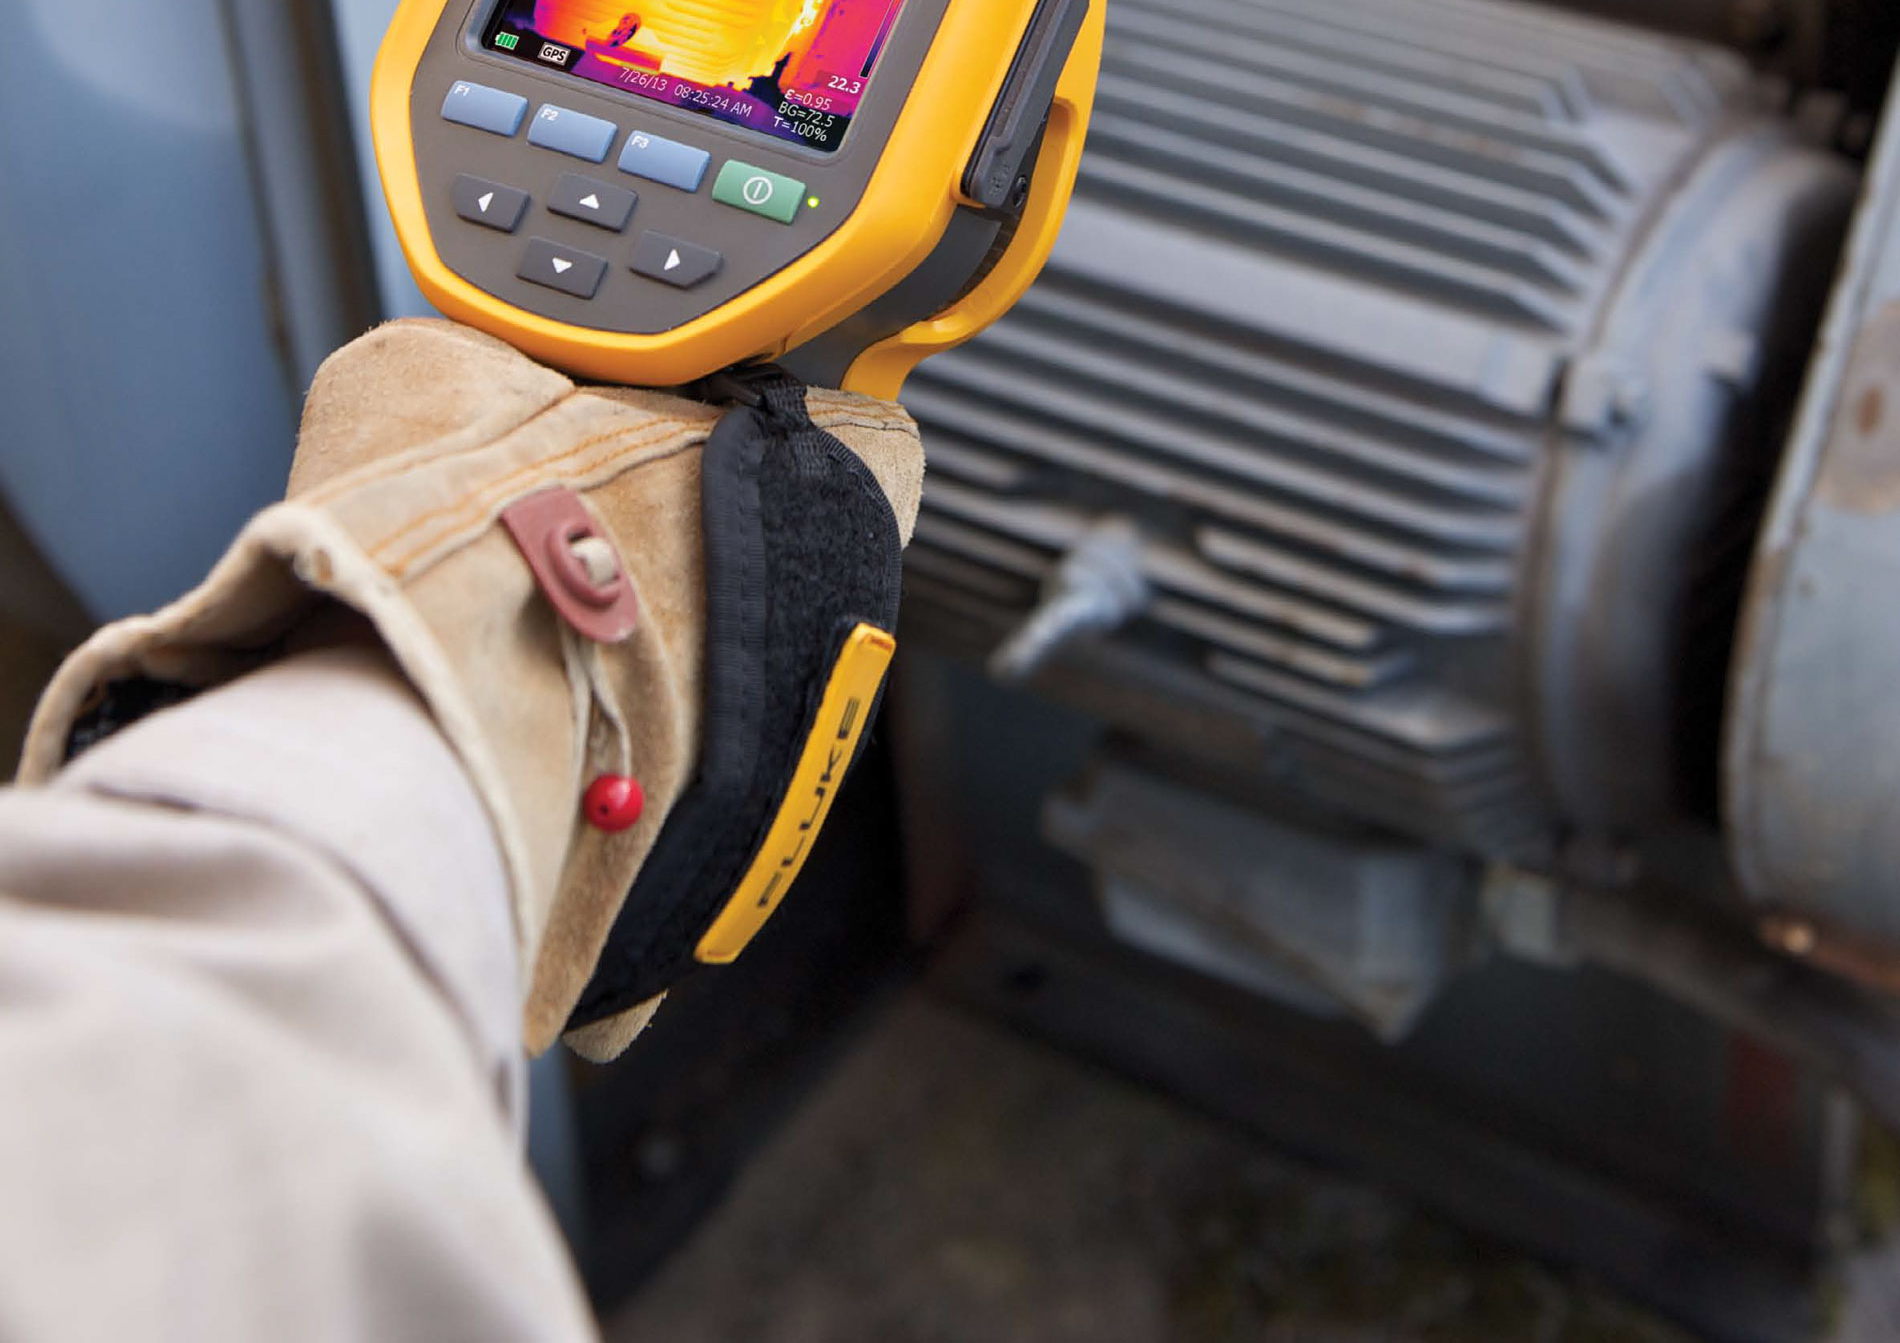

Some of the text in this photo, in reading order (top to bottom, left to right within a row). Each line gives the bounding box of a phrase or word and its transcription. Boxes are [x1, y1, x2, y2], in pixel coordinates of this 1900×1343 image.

[542, 46, 567, 61] GPS
[454, 83, 470, 97] F1
[619, 67, 753, 118] 7/26/13 08:25:24 AM
[827, 75, 862, 95] 22.3
[541, 108, 558, 122] F2
[774, 115, 828, 142] T=100%
[631, 134, 648, 149] F3
[757, 696, 861, 909] FLUKE
